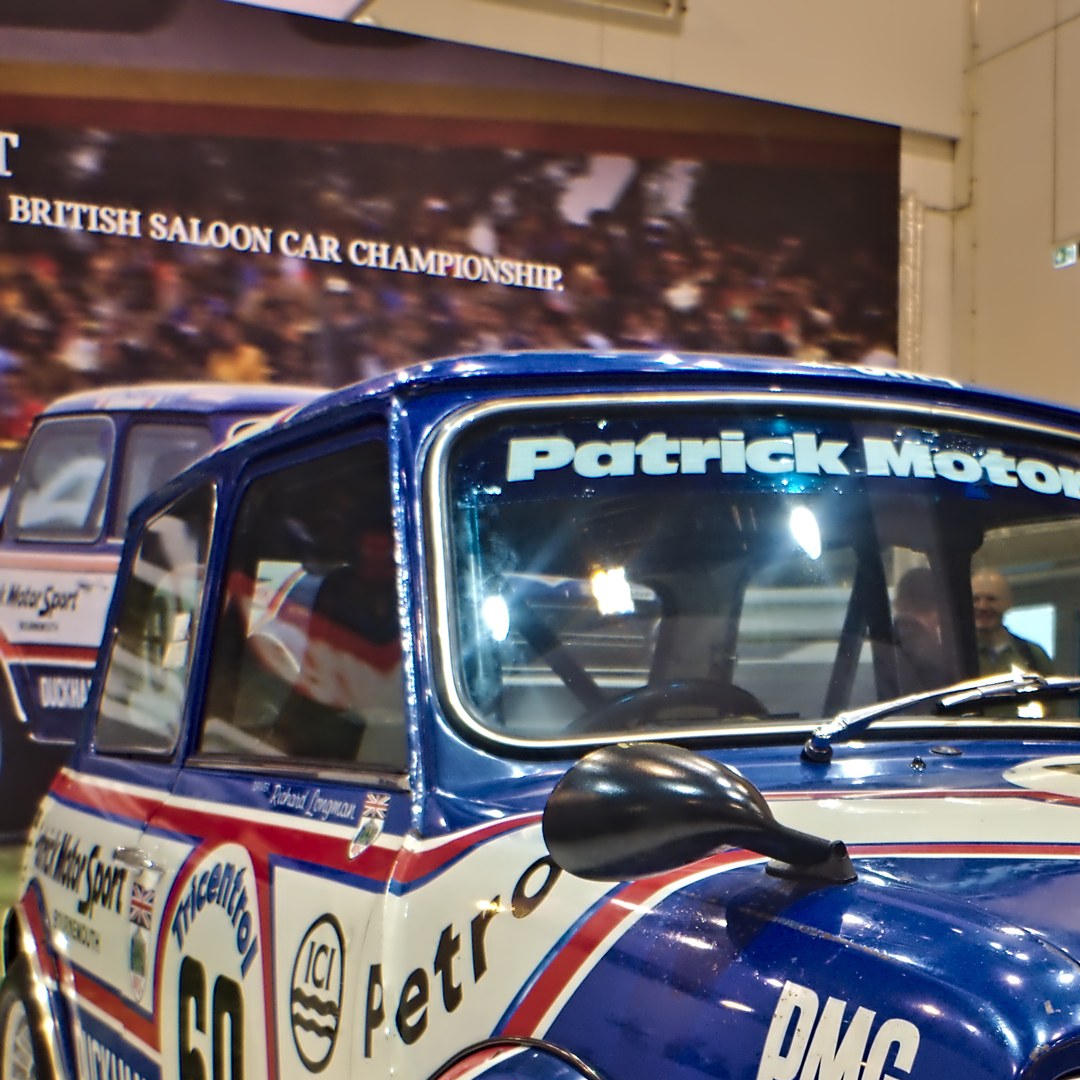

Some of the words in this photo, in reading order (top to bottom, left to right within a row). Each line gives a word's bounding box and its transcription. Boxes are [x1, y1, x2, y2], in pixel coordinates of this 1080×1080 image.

[8, 194, 142, 237] BRITISH
[149, 212, 273, 253] SALOON
[280, 230, 343, 263] CAR
[348, 240, 565, 291] CHAMPIONSHIP.
[506, 431, 850, 482] Patrick
[171, 862, 259, 980] Tricentrol
[304, 940, 337, 992] ICI
